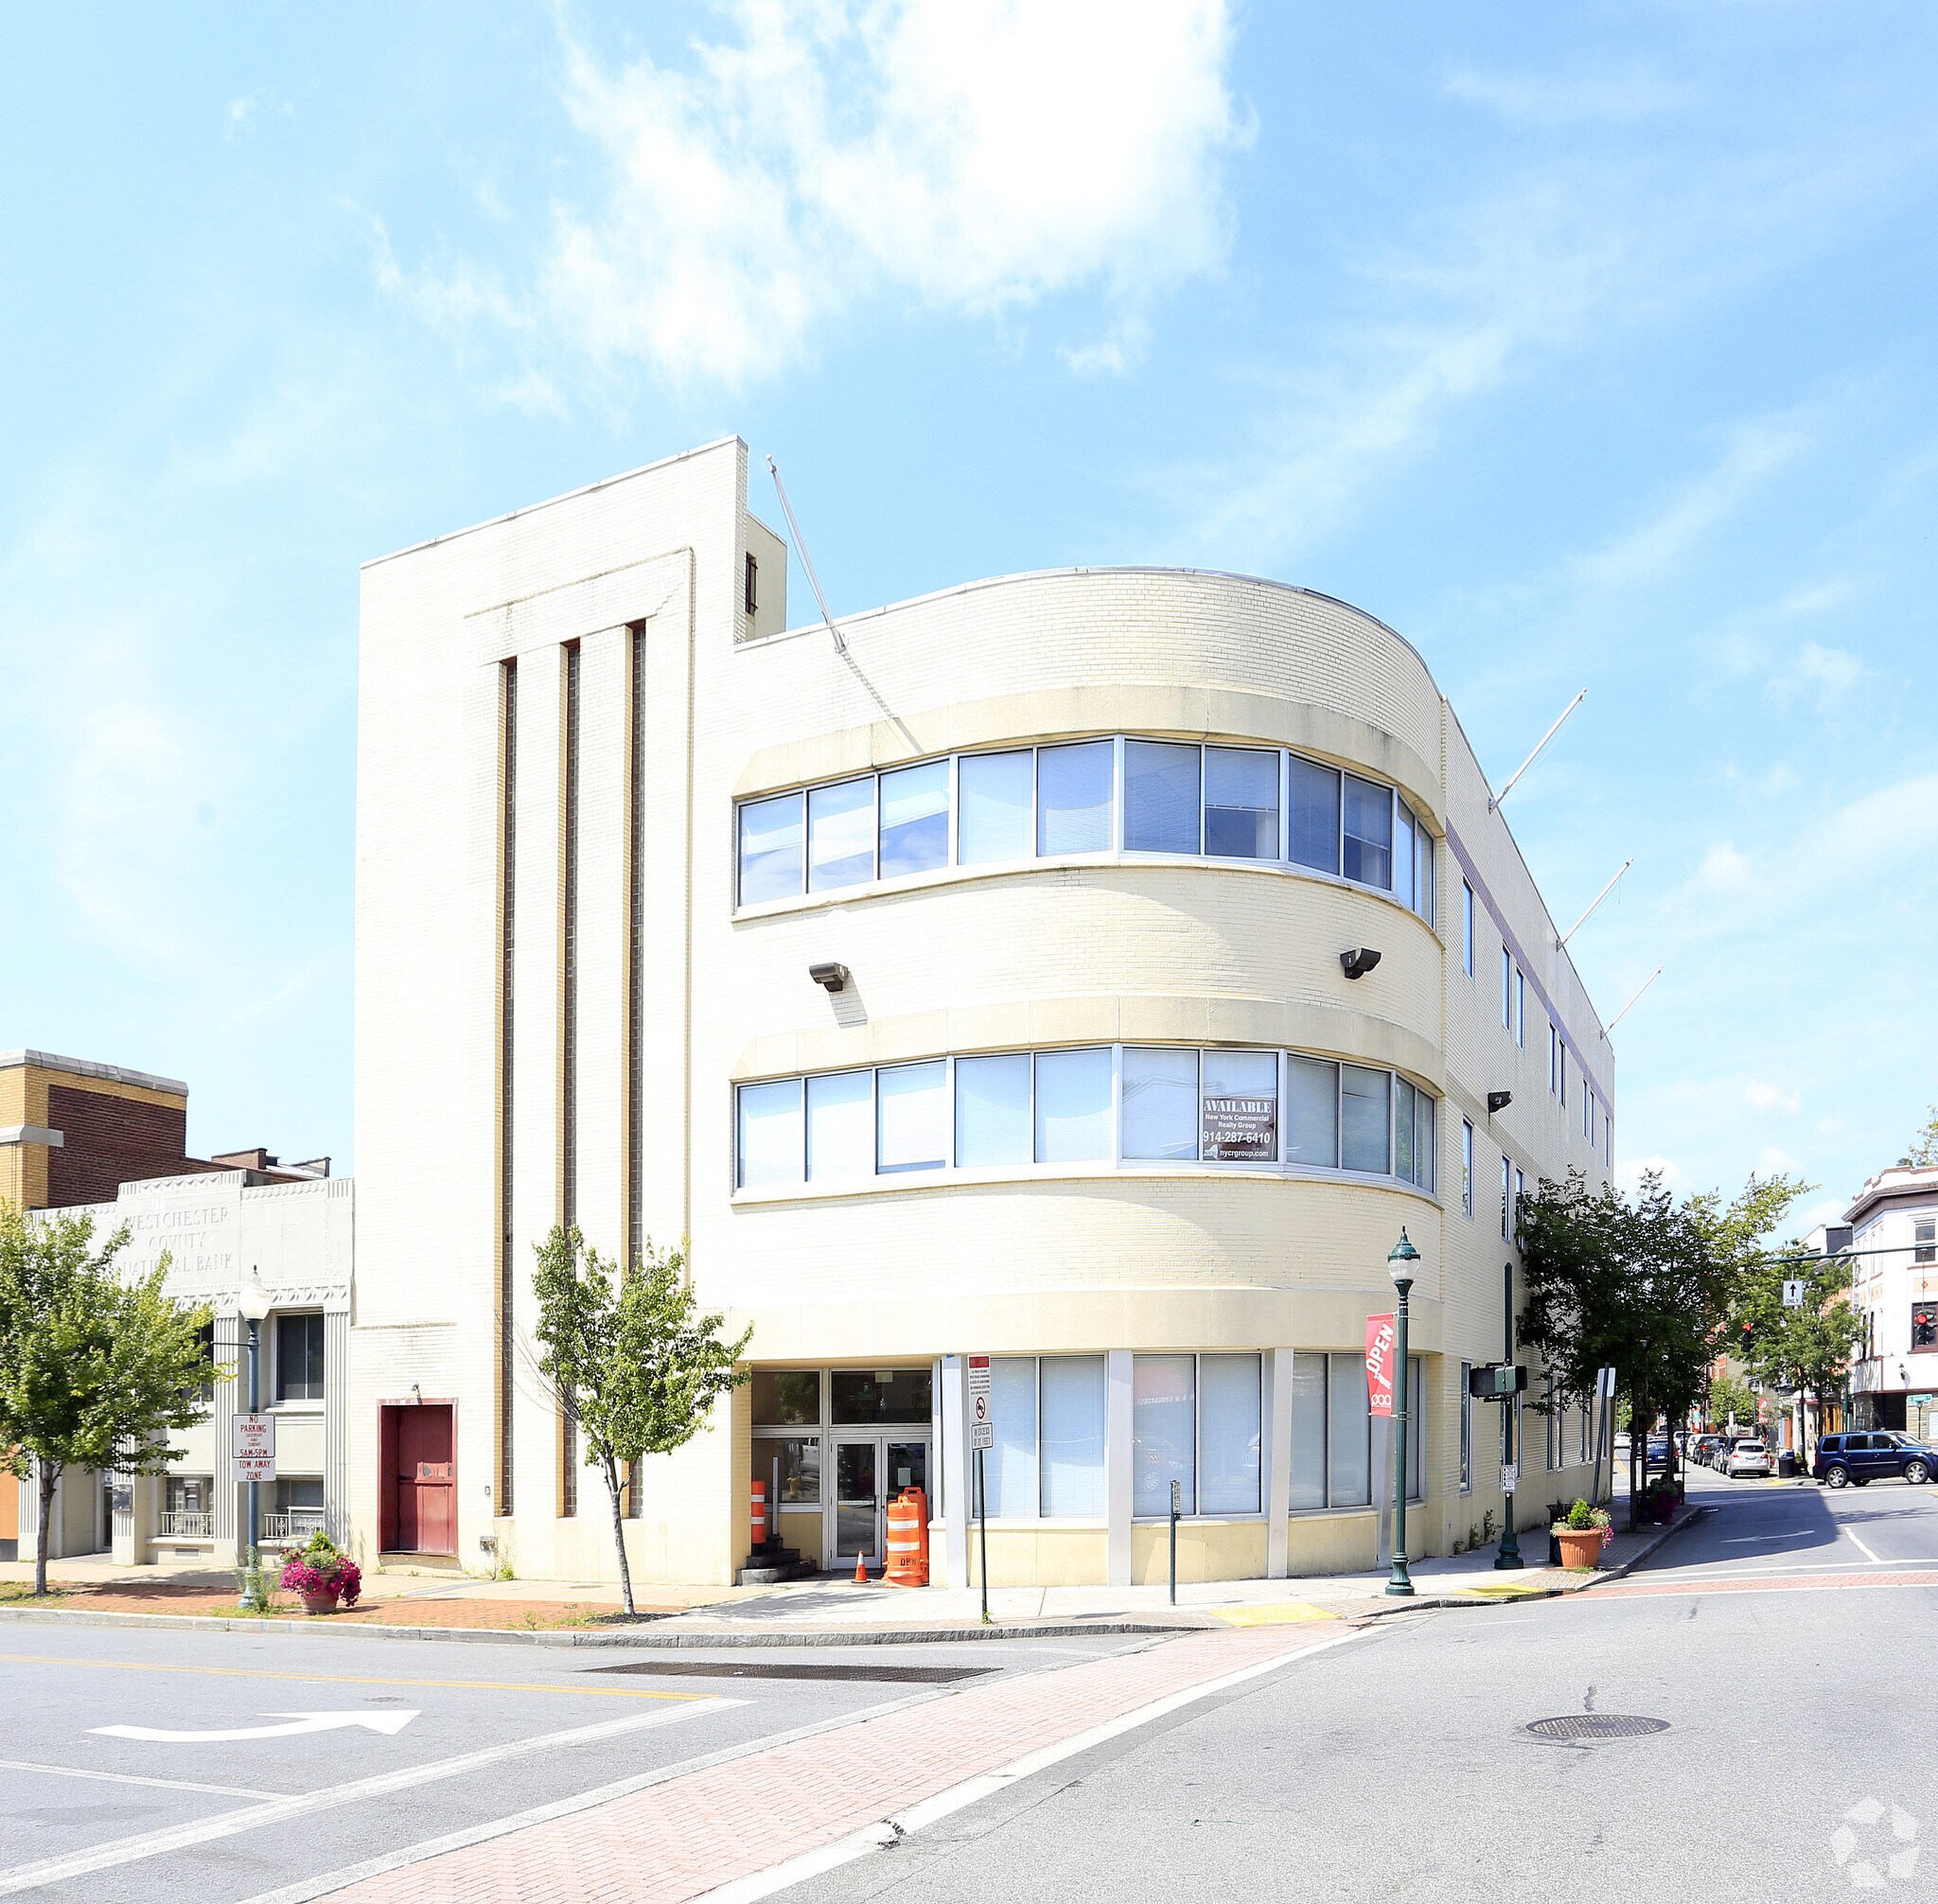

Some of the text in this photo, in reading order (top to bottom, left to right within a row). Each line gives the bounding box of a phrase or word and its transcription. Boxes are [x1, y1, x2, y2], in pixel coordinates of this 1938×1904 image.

[1204, 1100, 1272, 1114] AVAILABLE
[1238, 1121, 1257, 1130] Group
[1203, 1131, 1271, 1144] 914-287-6410
[1220, 1149, 1269, 1158] nycrgroup.com
[127, 1207, 231, 1231] WESTCHESTER
[123, 1253, 235, 1277] NATIOAL BANK
[1365, 1323, 1394, 1373] OPEN
[249, 1415, 258, 1423] NO
[240, 1424, 267, 1433] PARKING
[240, 1449, 268, 1457] 5AM-5PM
[238, 1460, 252, 1469] TOW
[246, 1472, 262, 1480] ZONE
